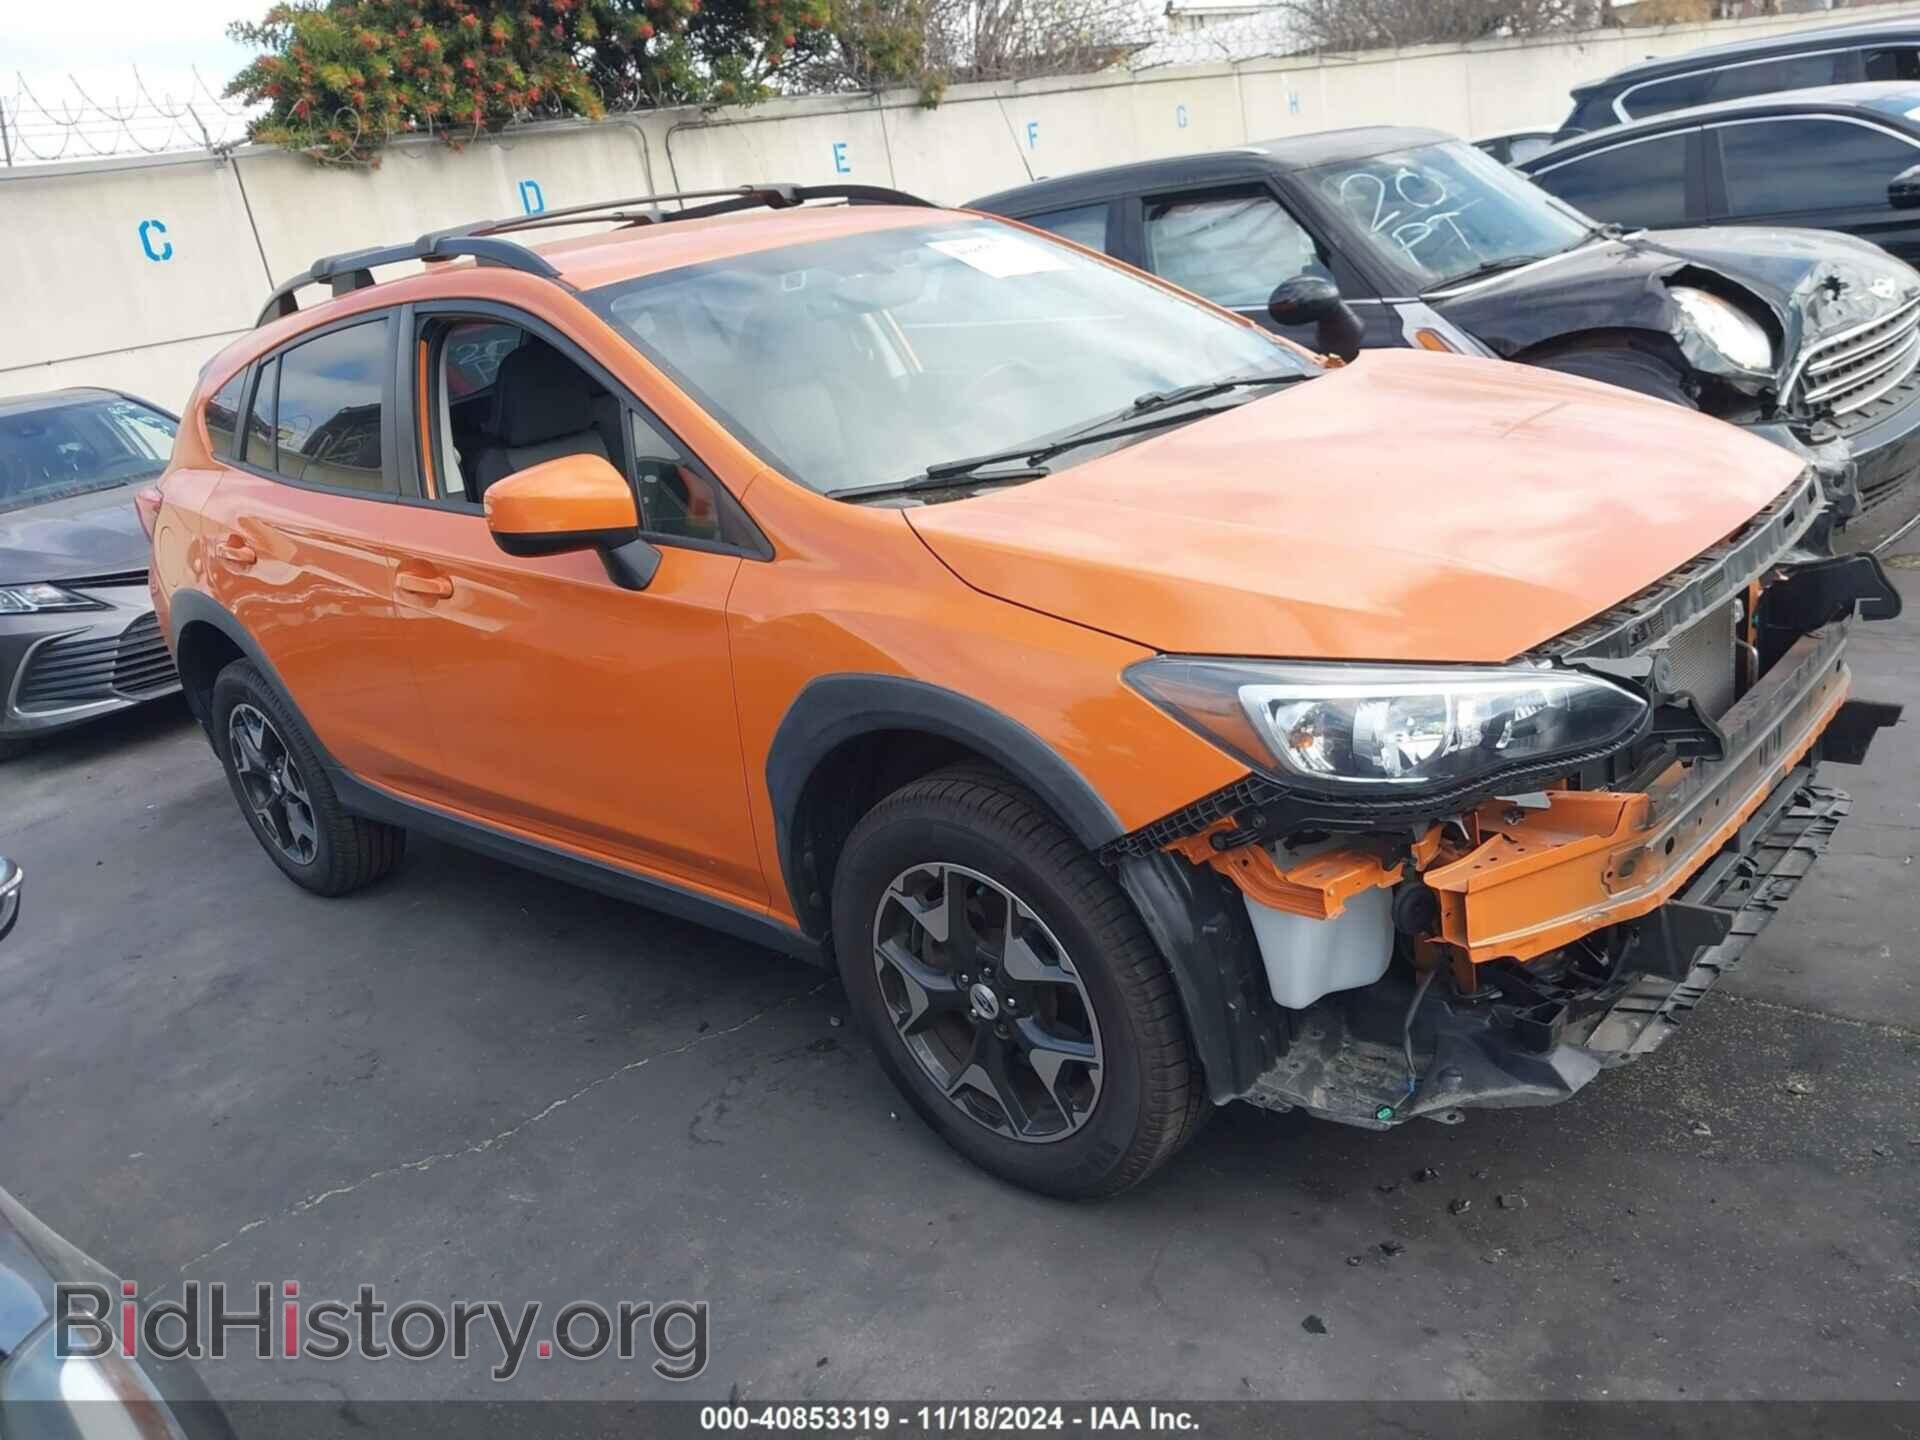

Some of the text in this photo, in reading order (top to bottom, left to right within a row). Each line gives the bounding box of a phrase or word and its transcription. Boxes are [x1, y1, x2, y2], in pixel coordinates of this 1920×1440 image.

[1027, 122, 1039, 149] F
[832, 142, 851, 173] E
[519, 179, 544, 216] D
[1340, 167, 1447, 233] 20
[138, 219, 173, 262] C
